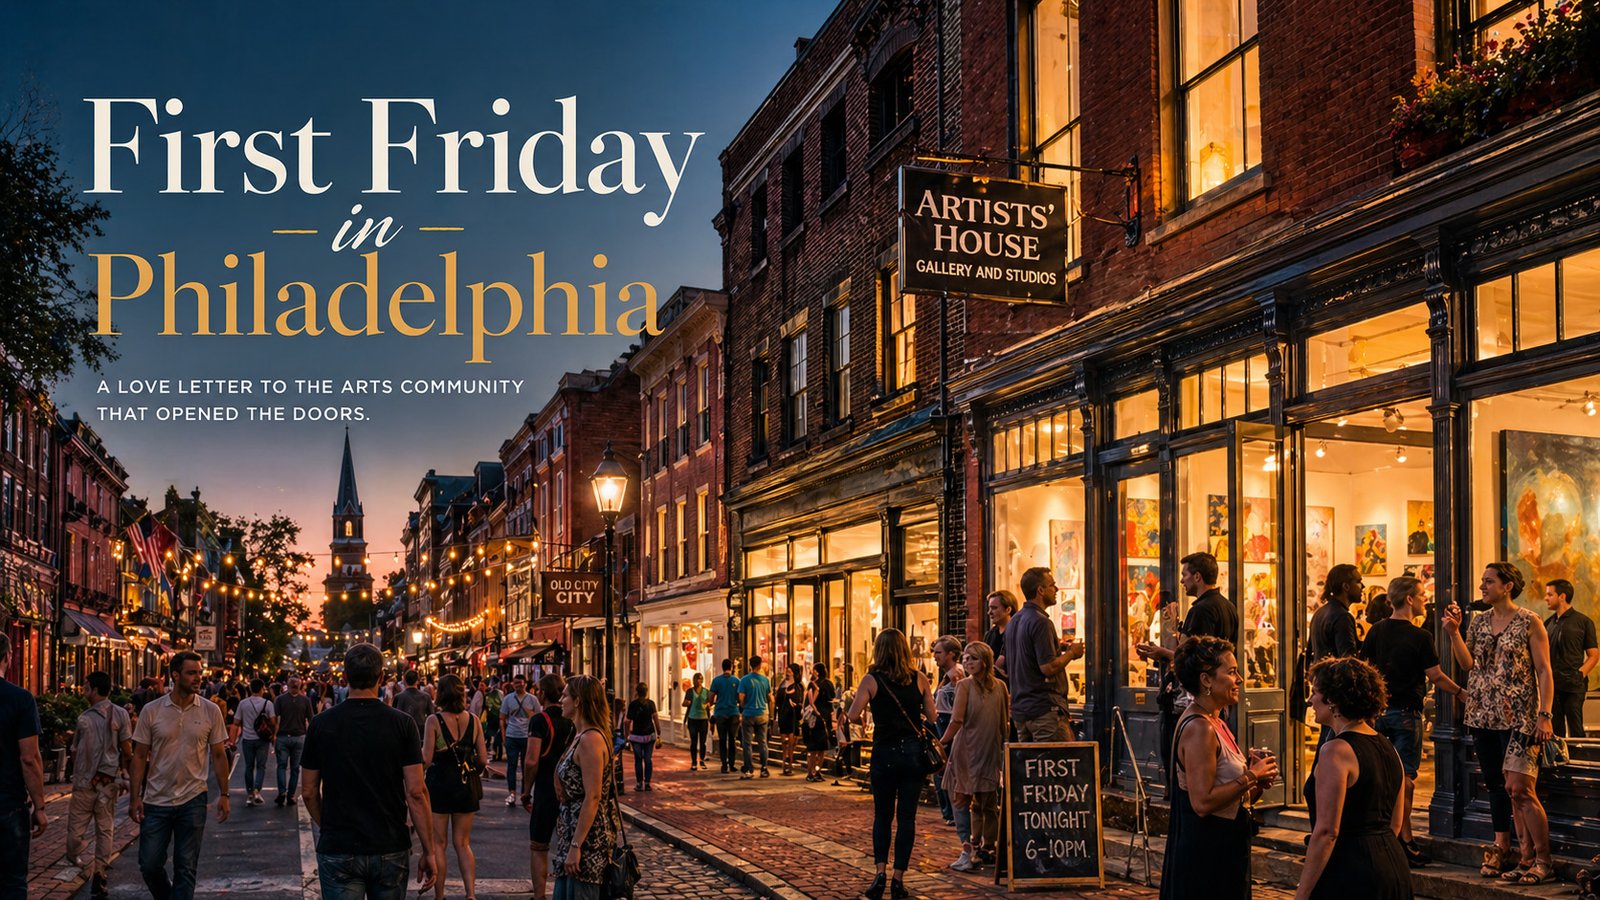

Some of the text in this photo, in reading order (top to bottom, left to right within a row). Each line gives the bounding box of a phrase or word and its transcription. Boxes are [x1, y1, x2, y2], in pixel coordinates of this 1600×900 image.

[915, 189, 1055, 230] ARTISTS'
[933, 223, 1041, 261] HOUSE
[915, 259, 1057, 286] GALLERY AND STUDIOS
[550, 579, 572, 591] OLD
[556, 591, 595, 604] CITY
[1025, 758, 1080, 778] FIRST
[1023, 783, 1089, 804] FRIDAY
[1018, 810, 1090, 830] TONIGHT
